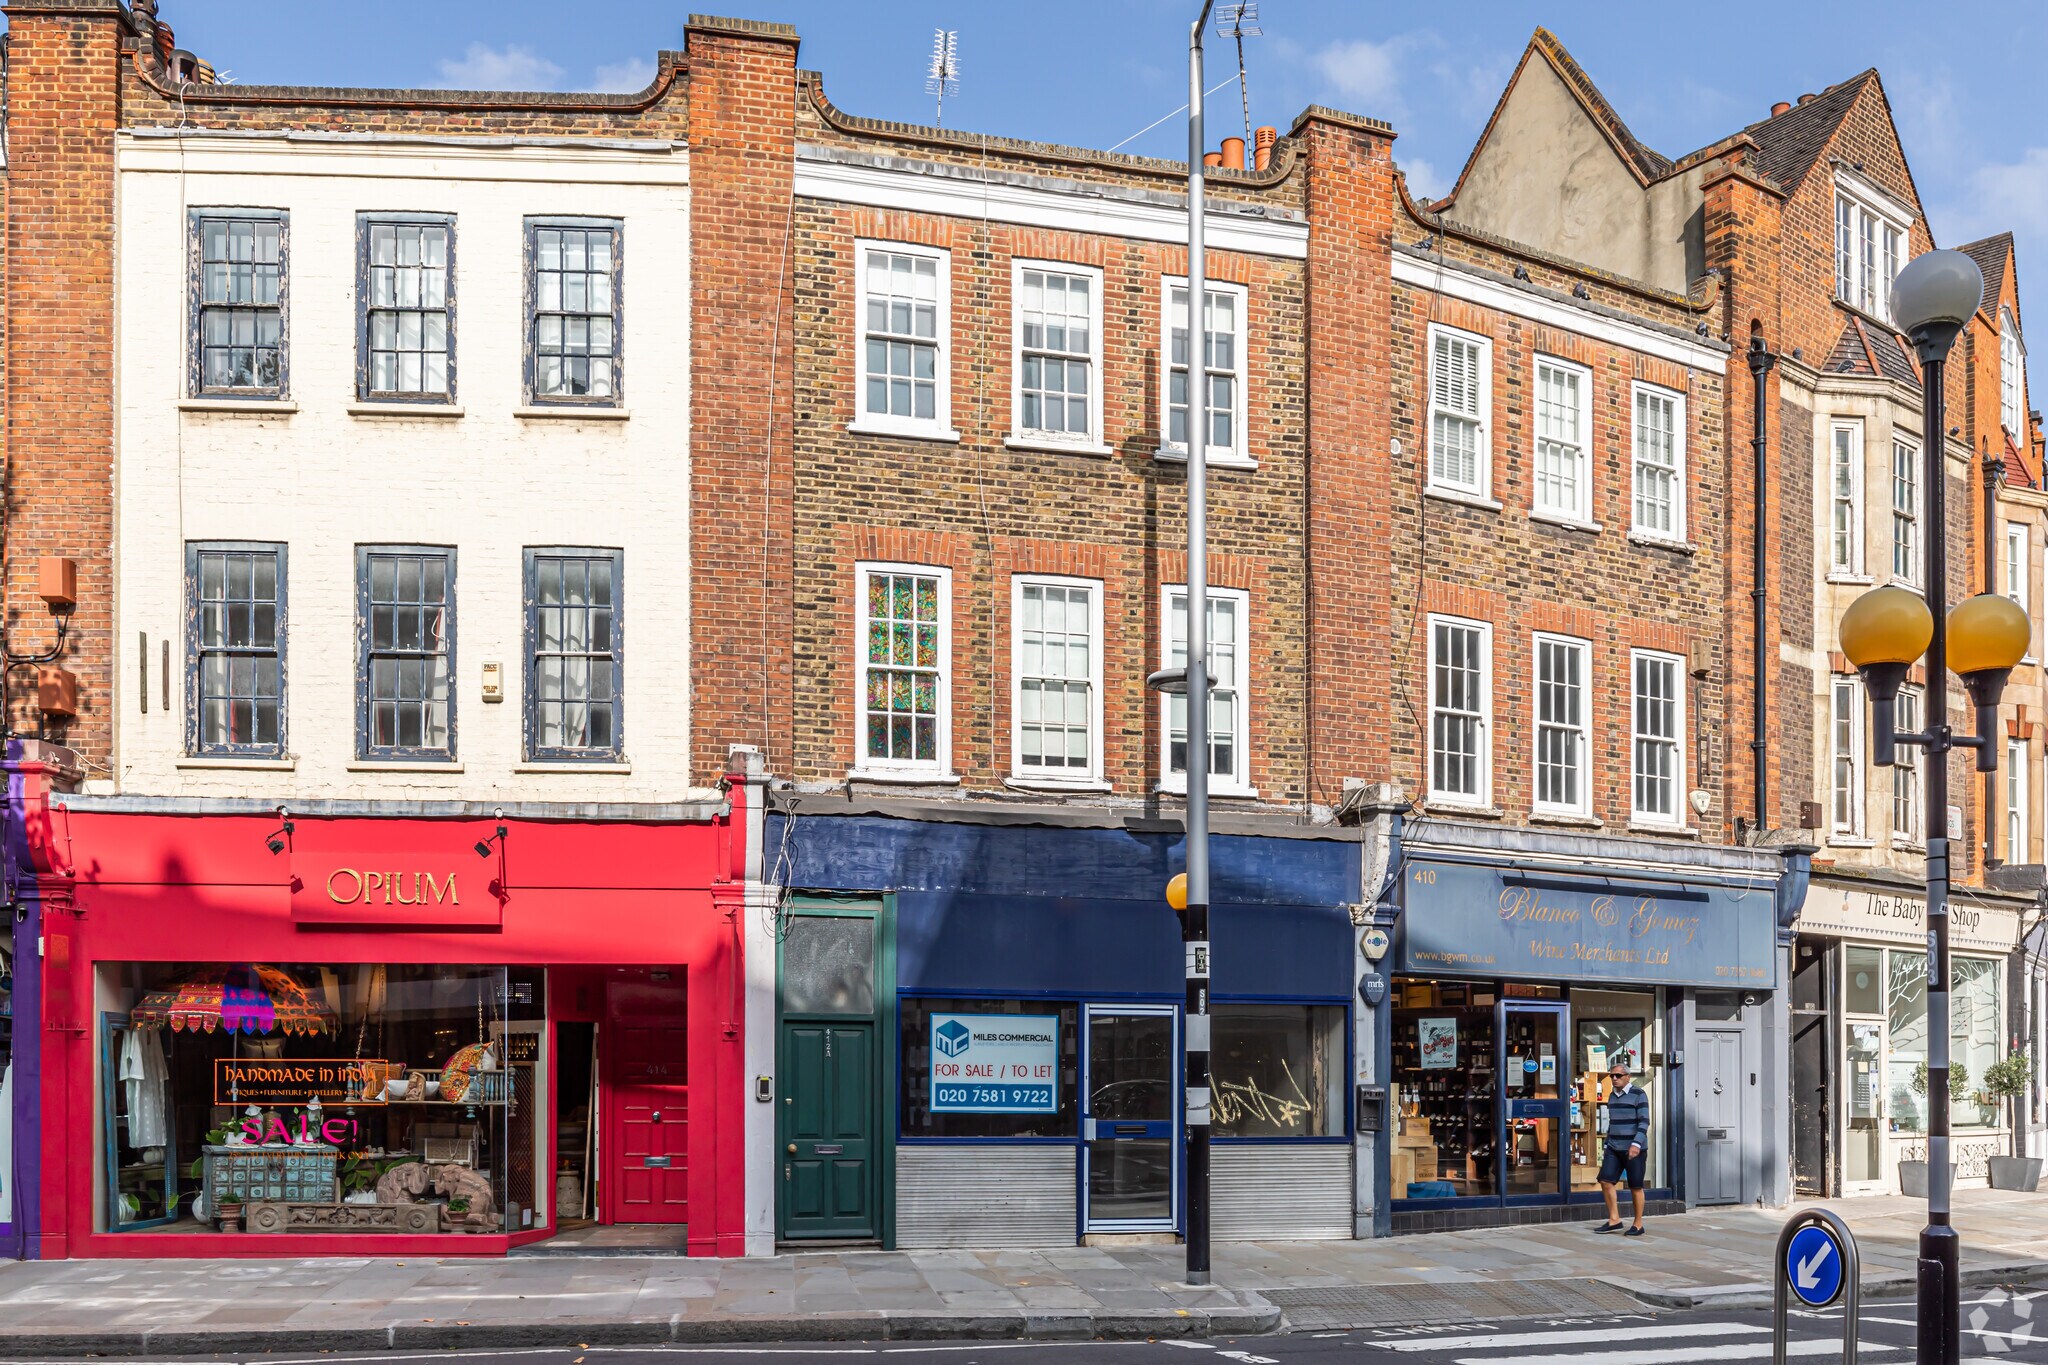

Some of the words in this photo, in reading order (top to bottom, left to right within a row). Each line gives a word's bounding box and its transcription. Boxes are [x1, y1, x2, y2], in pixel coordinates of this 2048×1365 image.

[1414, 870, 1436, 885] 410
[1498, 885, 1581, 922] Blanco
[1591, 894, 1619, 926] &
[1628, 893, 1699, 945] Gomez
[1866, 891, 1889, 917] The
[1892, 896, 1925, 926] Baby
[1951, 903, 1980, 932] Shop
[1367, 937, 1388, 947] eagle
[1414, 950, 1497, 965] www.bgwm.co.uk
[1530, 938, 1567, 959] Wine
[1570, 942, 1641, 963] Merchants
[1645, 944, 1670, 965] Ltd
[1928, 931, 1936, 986] S03
[973, 1033, 998, 1042] MILES
[998, 1033, 1054, 1042] COMMERCIAL
[647, 1065, 667, 1075] 414
[935, 1064, 960, 1077] FOR
[966, 1064, 993, 1077] SALE
[1012, 1065, 1028, 1077] TO
[1034, 1065, 1052, 1078] LET
[307, 1089, 343, 1097] JEWELLERY
[939, 1089, 967, 1102] 020
[972, 1089, 1006, 1102] 7581
[1012, 1090, 1048, 1103] 9722
[241, 1114, 358, 1147] SALE!
